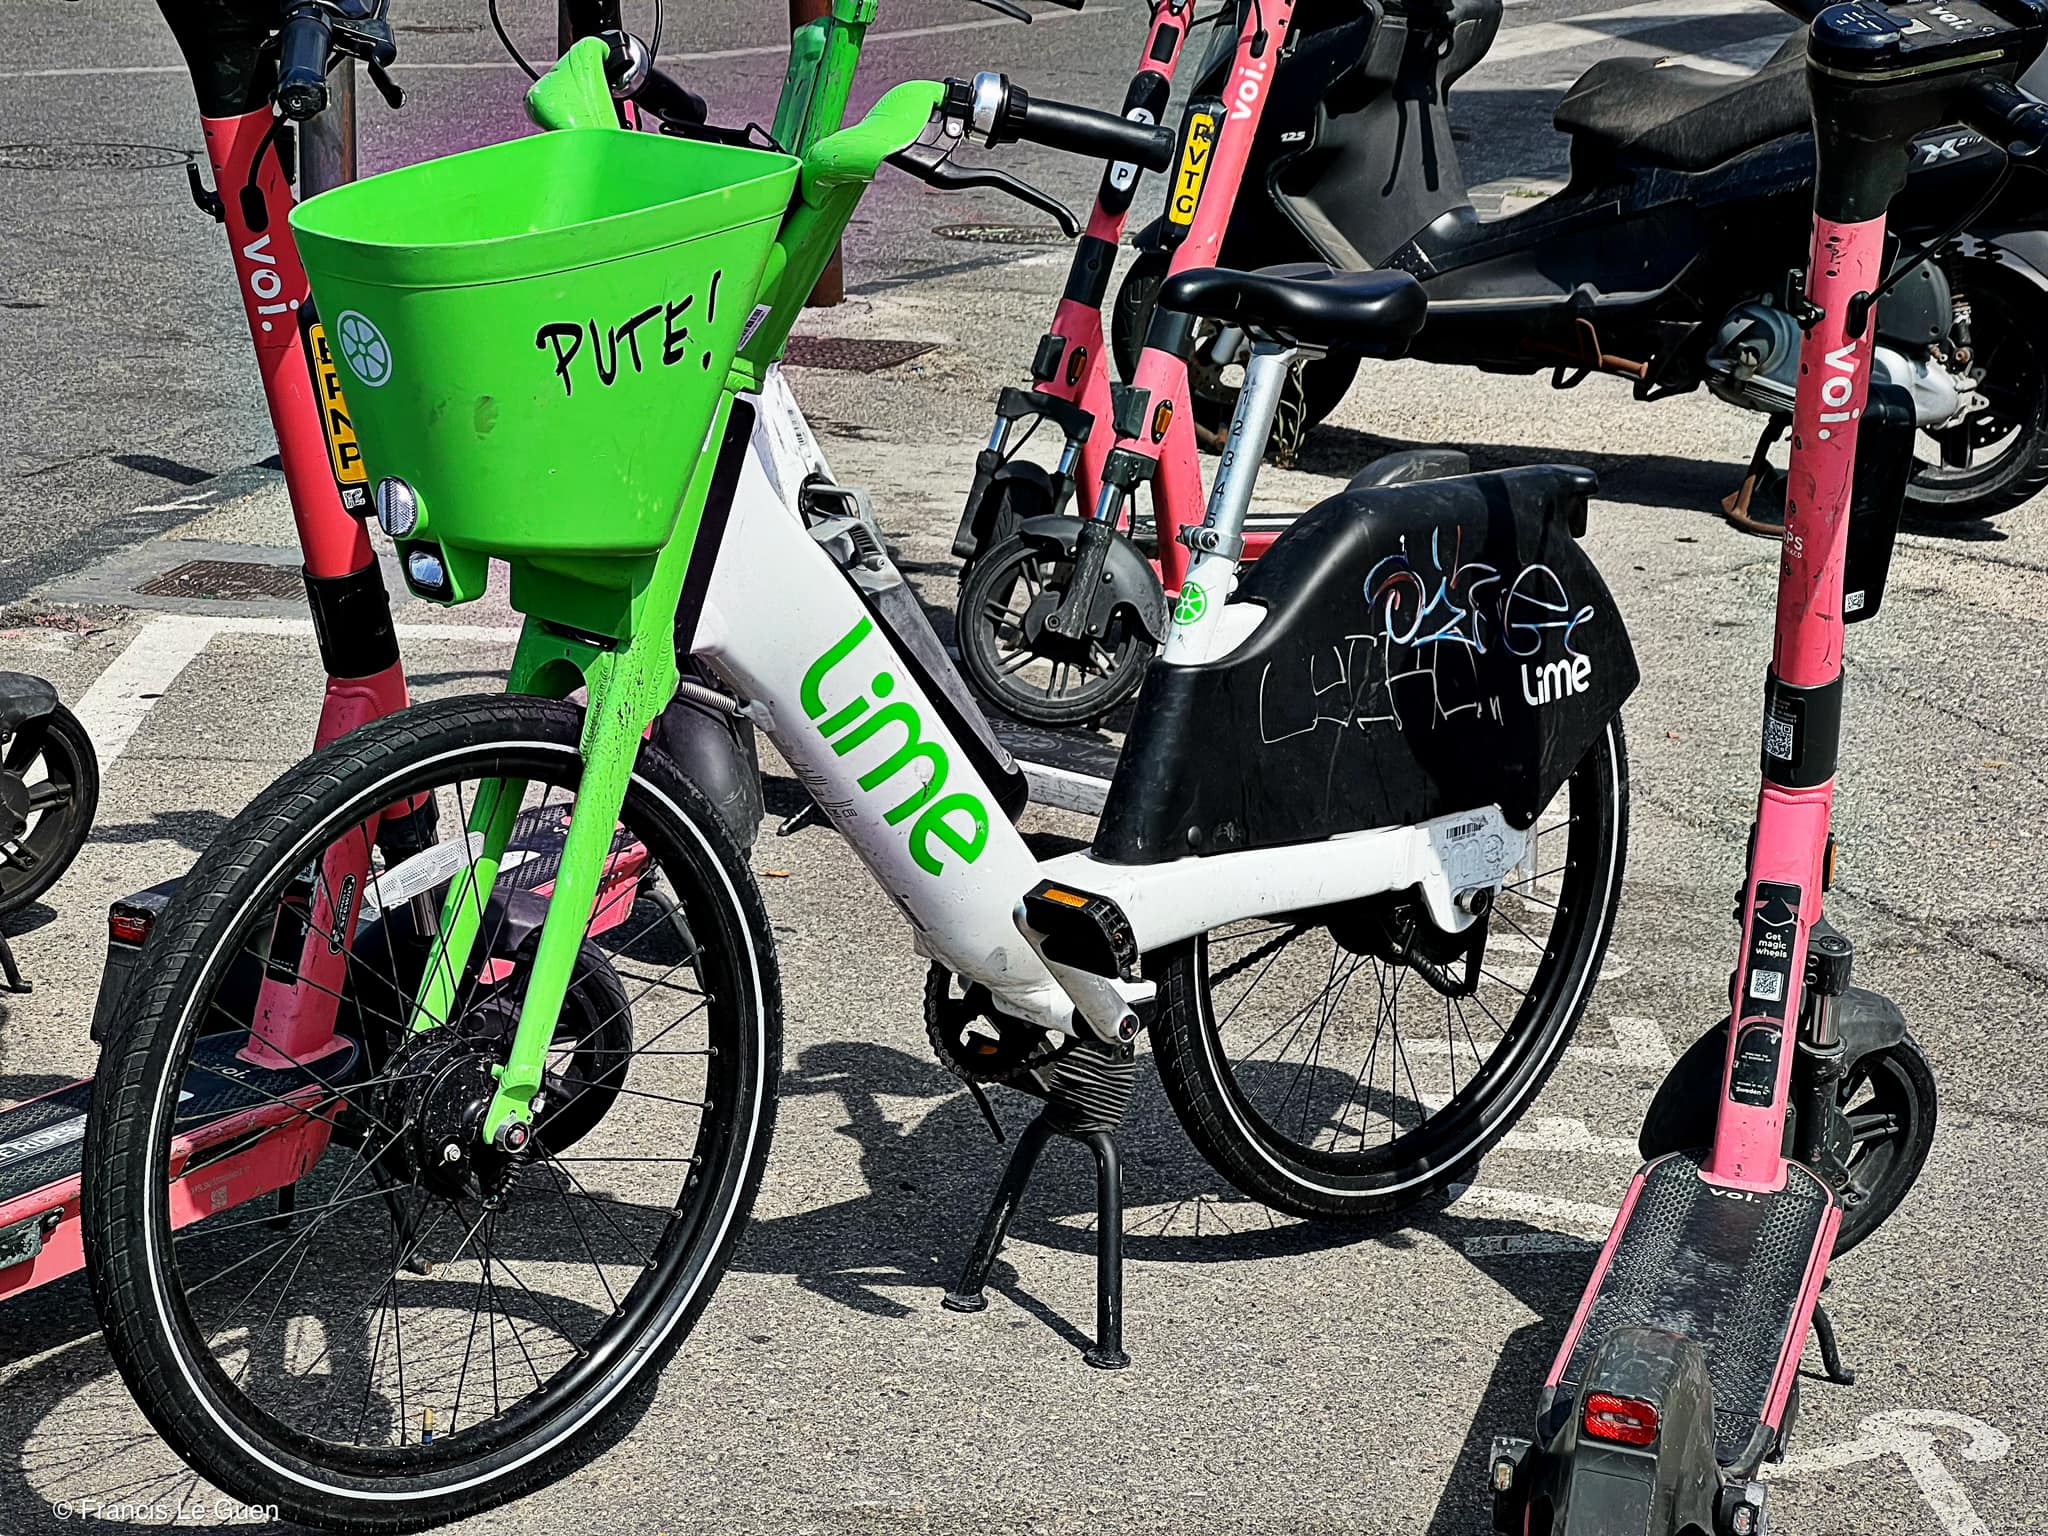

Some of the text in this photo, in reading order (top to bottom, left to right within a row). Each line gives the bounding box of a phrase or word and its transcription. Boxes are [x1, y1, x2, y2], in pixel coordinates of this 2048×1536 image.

[1230, 61, 1267, 120] voi.
[1280, 131, 1306, 142] 125
[243, 234, 299, 332] voi.
[536, 269, 721, 397] PUTE!
[1242, 390, 1249, 405] 1
[1818, 341, 1860, 440] voi.
[1233, 420, 1243, 436] 2
[1223, 452, 1234, 467] 3
[1216, 482, 1225, 497] 4
[1206, 512, 1216, 529] 5
[1765, 932, 1782, 941] Get
[1755, 947, 1788, 958] wheels
[1758, 940, 1787, 950] magic
[1709, 1187, 1761, 1203] voi.
